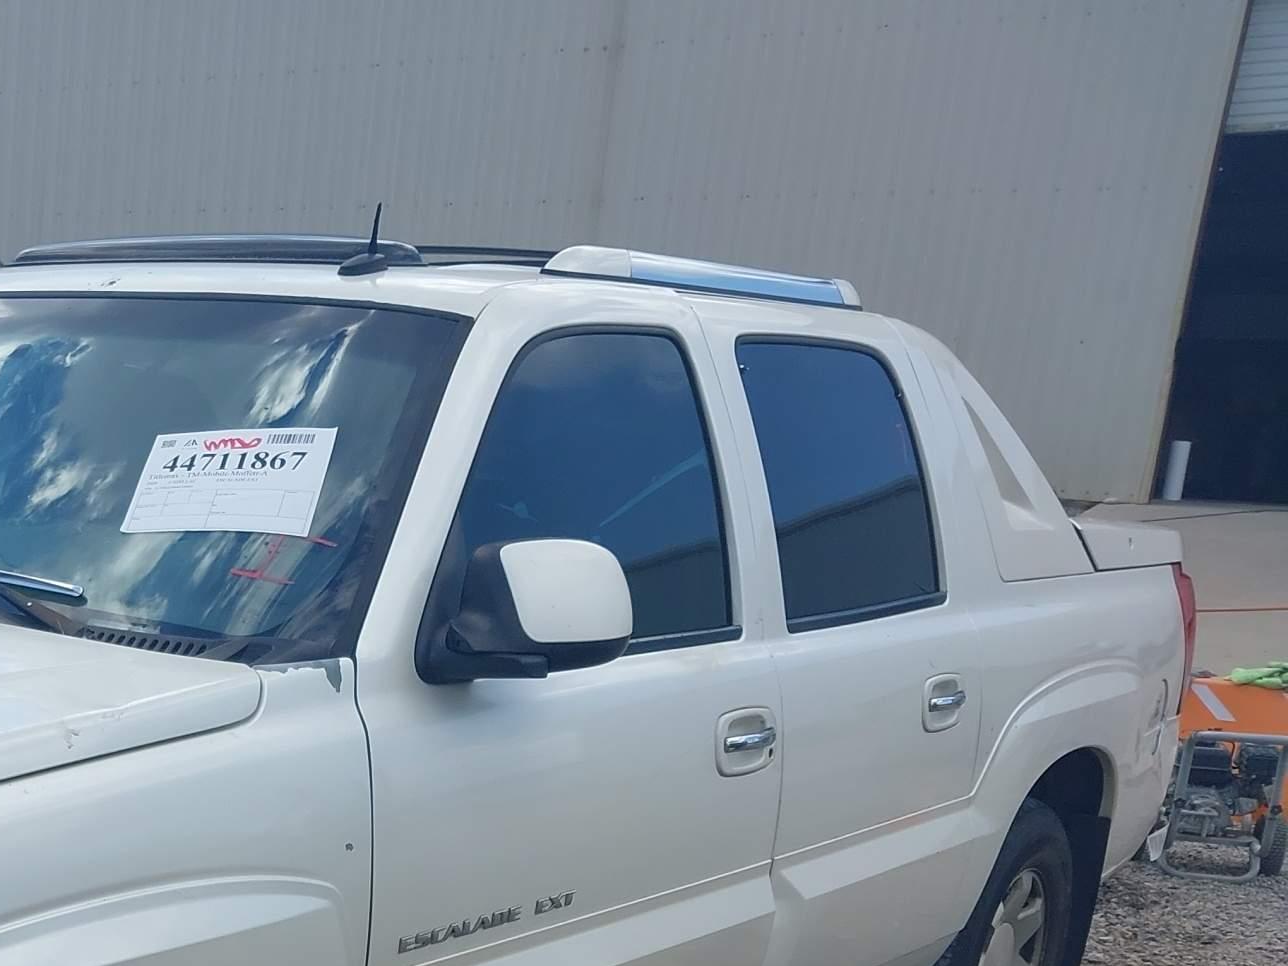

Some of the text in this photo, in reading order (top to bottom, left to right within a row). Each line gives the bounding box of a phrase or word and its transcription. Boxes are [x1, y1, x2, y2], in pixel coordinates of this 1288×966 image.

[163, 451, 308, 473] 44711867
[397, 889, 577, 954] ESCALADE EXT
